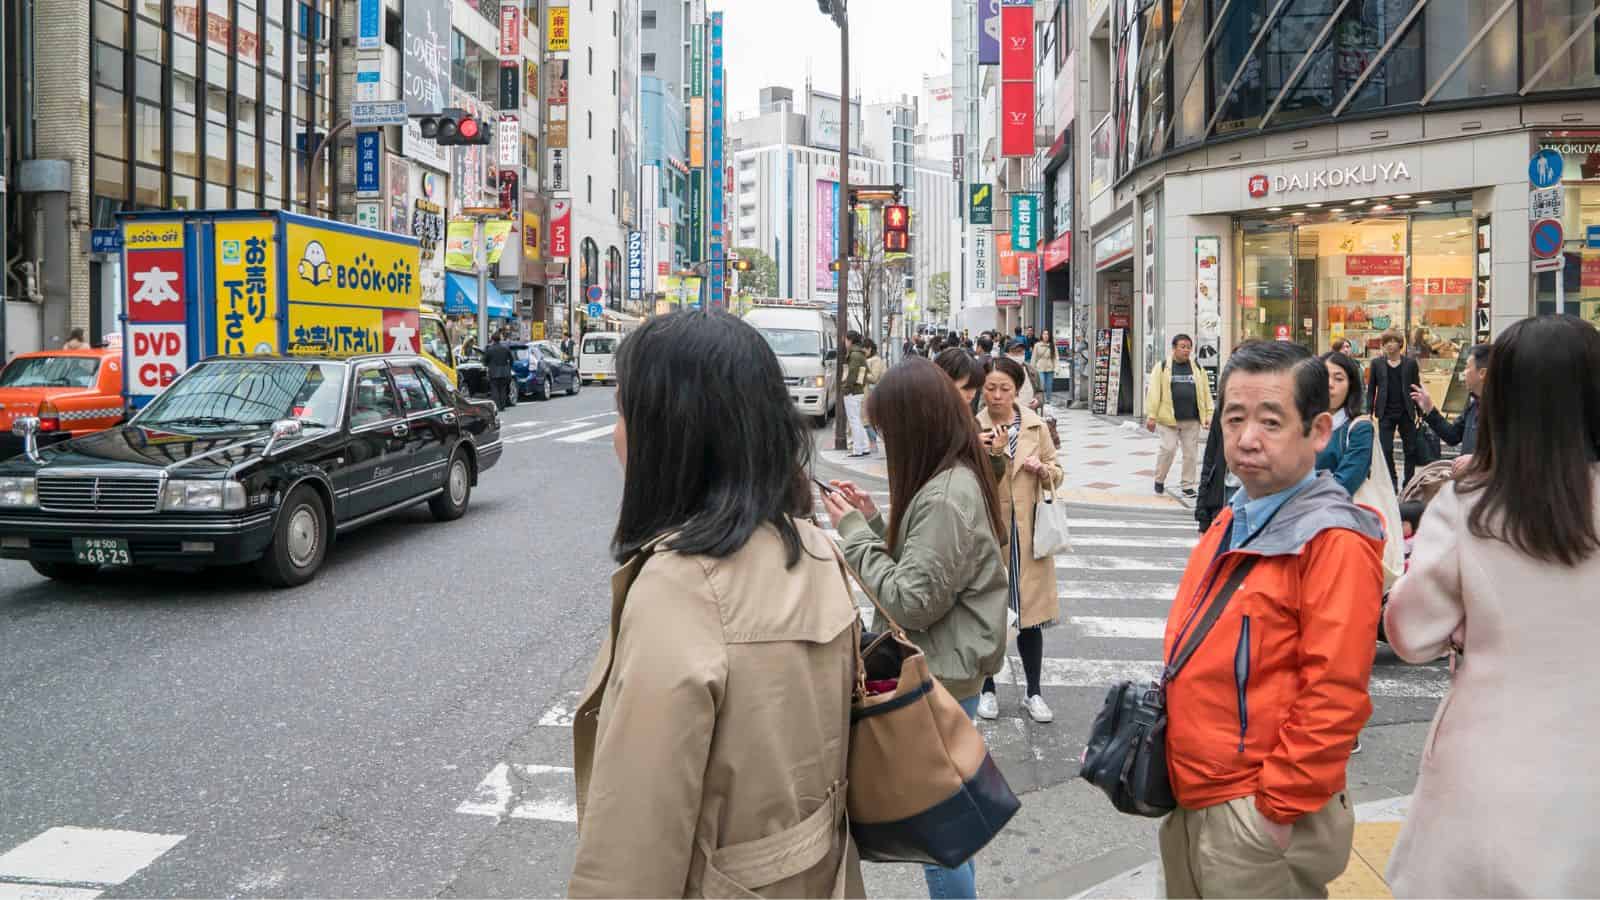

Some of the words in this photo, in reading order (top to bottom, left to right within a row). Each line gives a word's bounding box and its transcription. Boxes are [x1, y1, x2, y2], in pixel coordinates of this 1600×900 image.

[1274, 160, 1411, 193] DAIKOKUYA
[133, 266, 179, 306] 本
[245, 236, 267, 323] お売り
[223, 280, 244, 354] 下さい
[133, 332, 180, 356] DVD
[389, 322, 416, 353] 本
[138, 363, 178, 387] CD
[88, 548, 129, 564] 68-29
